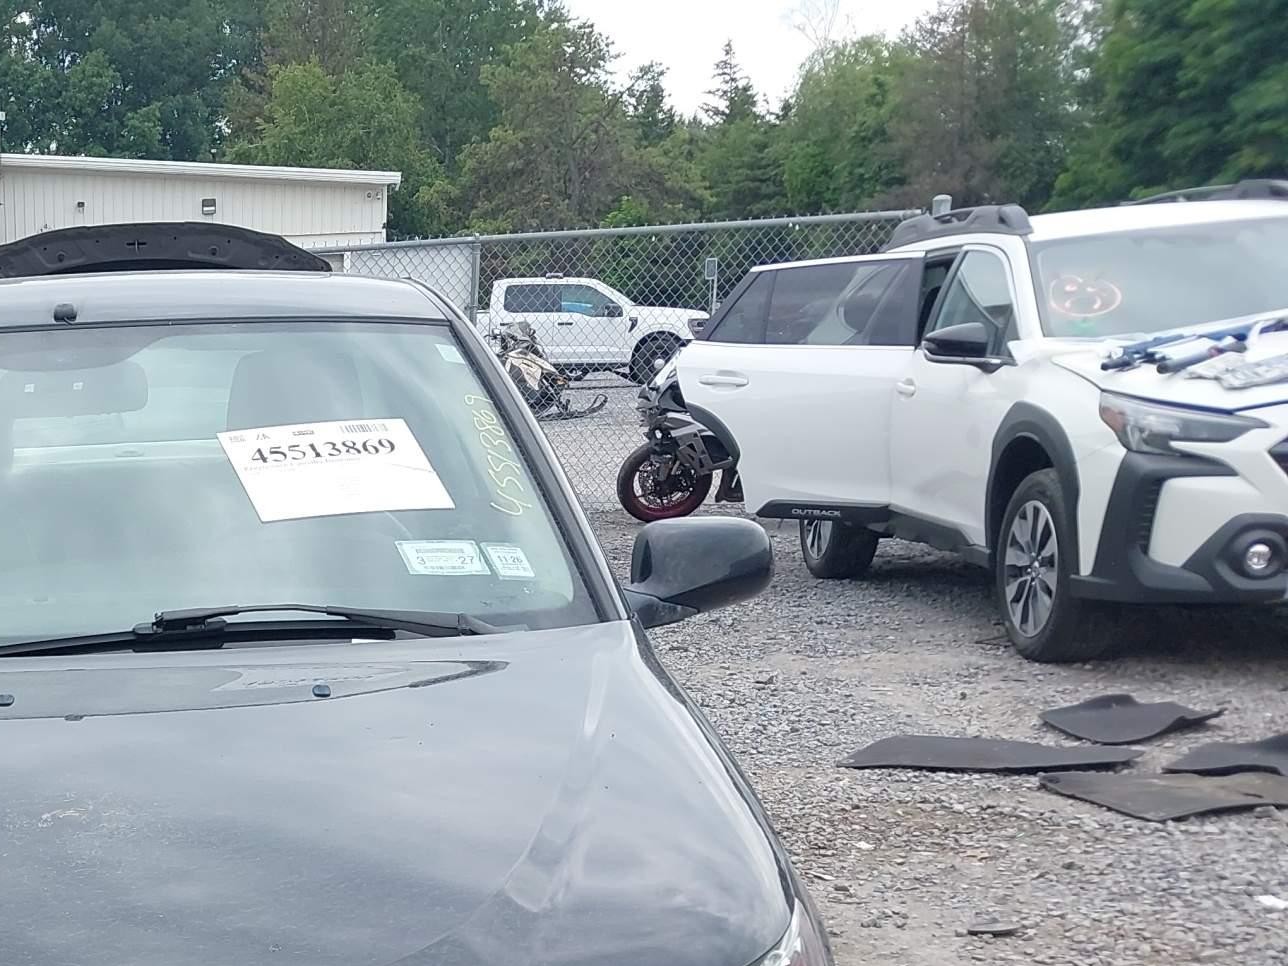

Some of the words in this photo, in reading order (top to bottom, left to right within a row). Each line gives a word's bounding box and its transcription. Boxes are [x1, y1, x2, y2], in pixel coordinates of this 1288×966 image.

[250, 437, 396, 464] 45513869
[464, 394, 533, 517] 45513869
[791, 508, 841, 517] OUTBACK
